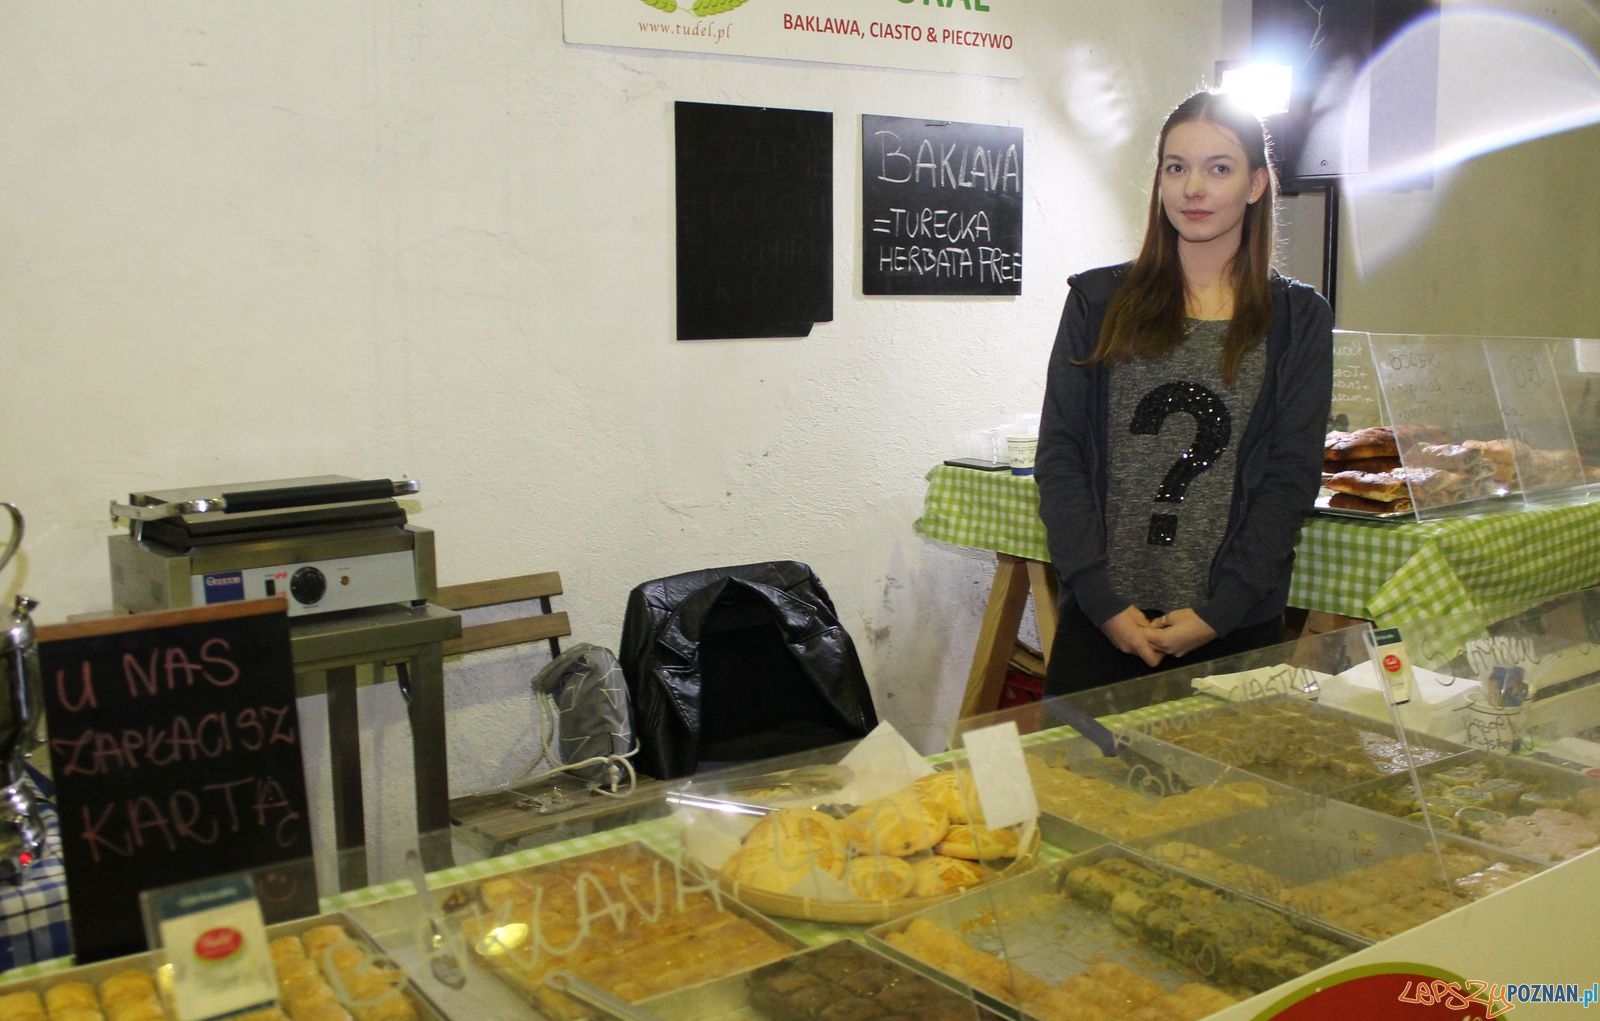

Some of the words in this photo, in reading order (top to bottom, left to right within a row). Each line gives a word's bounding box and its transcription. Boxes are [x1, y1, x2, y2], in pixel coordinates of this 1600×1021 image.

[638, 20, 733, 44] www.tudel.pl
[783, 13, 865, 39] BAKLAWA,
[869, 21, 922, 42] CIASTO
[926, 26, 938, 43] &
[942, 28, 1013, 50] PIECZYWO
[873, 130, 1020, 193] BAKLAVA
[879, 245, 973, 278] HERBATA
[56, 660, 97, 712] U
[122, 638, 240, 698] NAS
